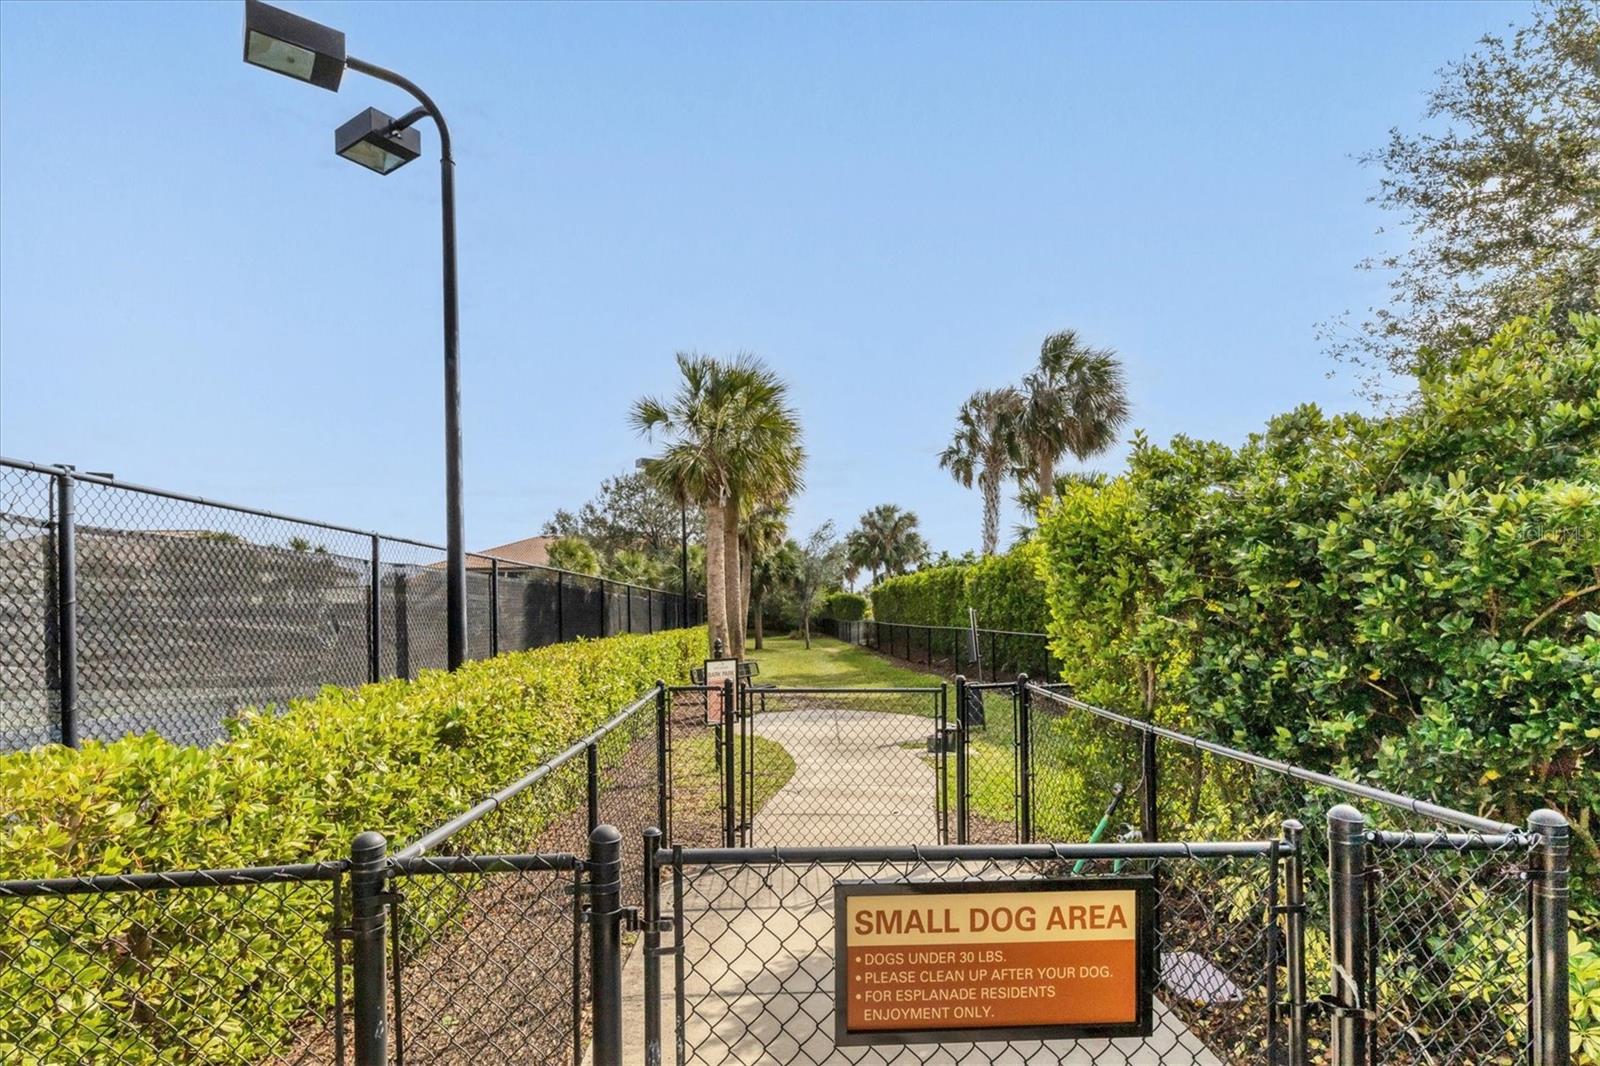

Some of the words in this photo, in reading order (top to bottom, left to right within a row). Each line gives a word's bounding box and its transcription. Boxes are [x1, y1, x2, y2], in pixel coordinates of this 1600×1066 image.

[855, 909, 959, 935] SMALL
[970, 907, 1036, 931] DOG
[1046, 905, 1127, 930] AREA
[865, 953, 904, 965] DOGS
[908, 952, 956, 964] UNDER
[959, 952, 974, 963] 30
[979, 951, 1006, 962] LBS.
[865, 971, 916, 984] PLEASE
[920, 970, 964, 982] CLEAN
[969, 969, 987, 981] UP
[991, 969, 1033, 981] AFTER
[1037, 967, 1075, 979] YOUR
[1079, 966, 1113, 978] DOG.
[865, 991, 891, 1002] FOR
[896, 988, 976, 1001] ESPLANADE
[980, 986, 1056, 1000] RESIDENTS
[864, 1007, 949, 1021] ENJOYMENT
[954, 1006, 994, 1019] ONLY.
